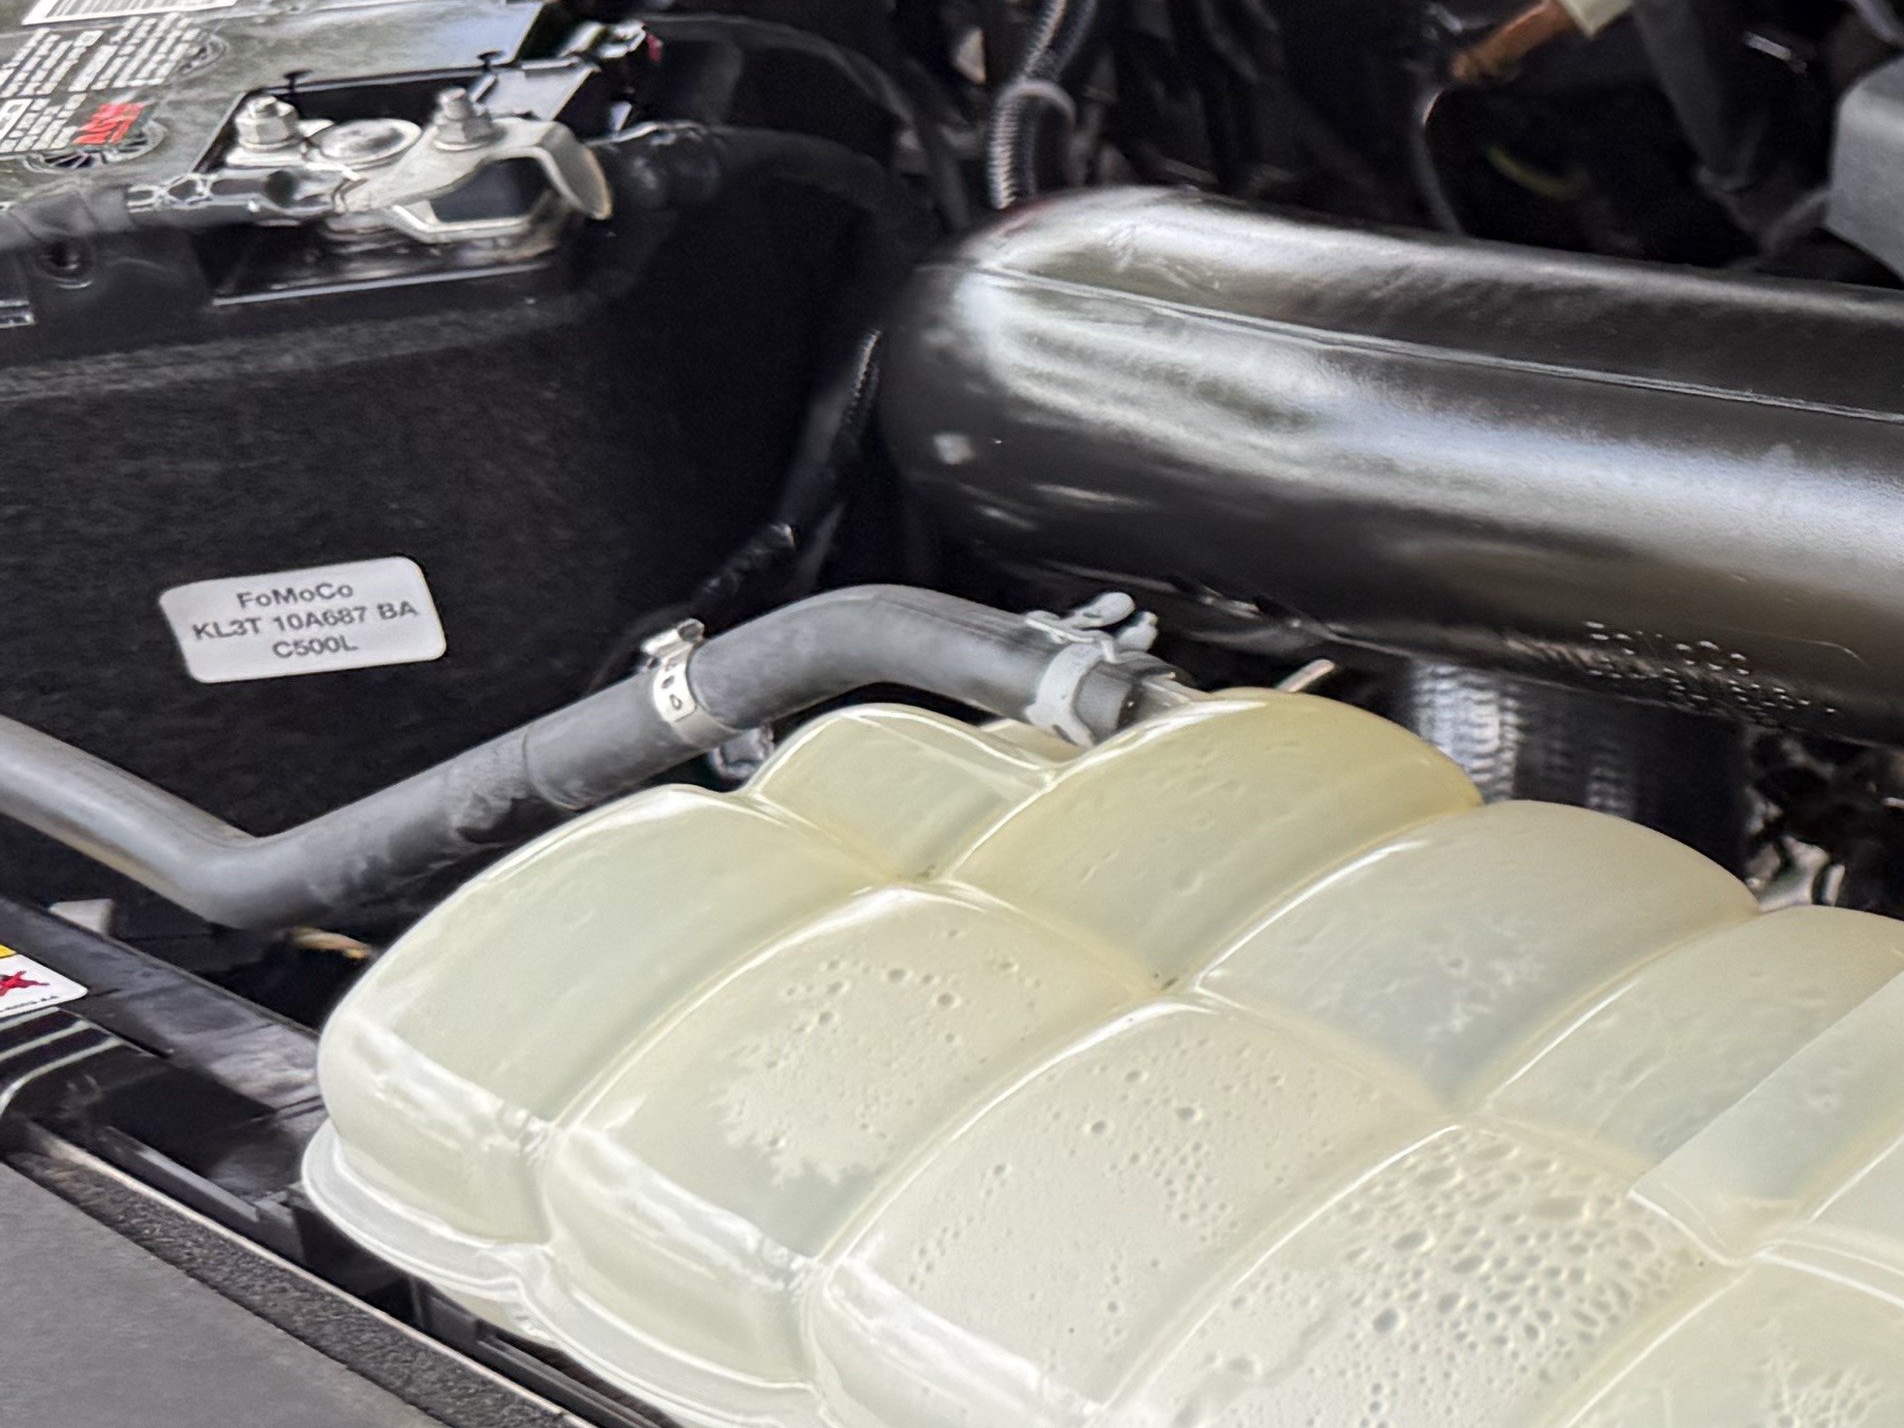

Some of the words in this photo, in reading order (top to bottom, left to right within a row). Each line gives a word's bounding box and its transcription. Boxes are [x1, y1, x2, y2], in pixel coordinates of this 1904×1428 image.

[236, 582, 354, 609] FoMoCo
[192, 616, 261, 641] KL3T
[376, 600, 419, 621] BA
[272, 635, 359, 659] C500L
